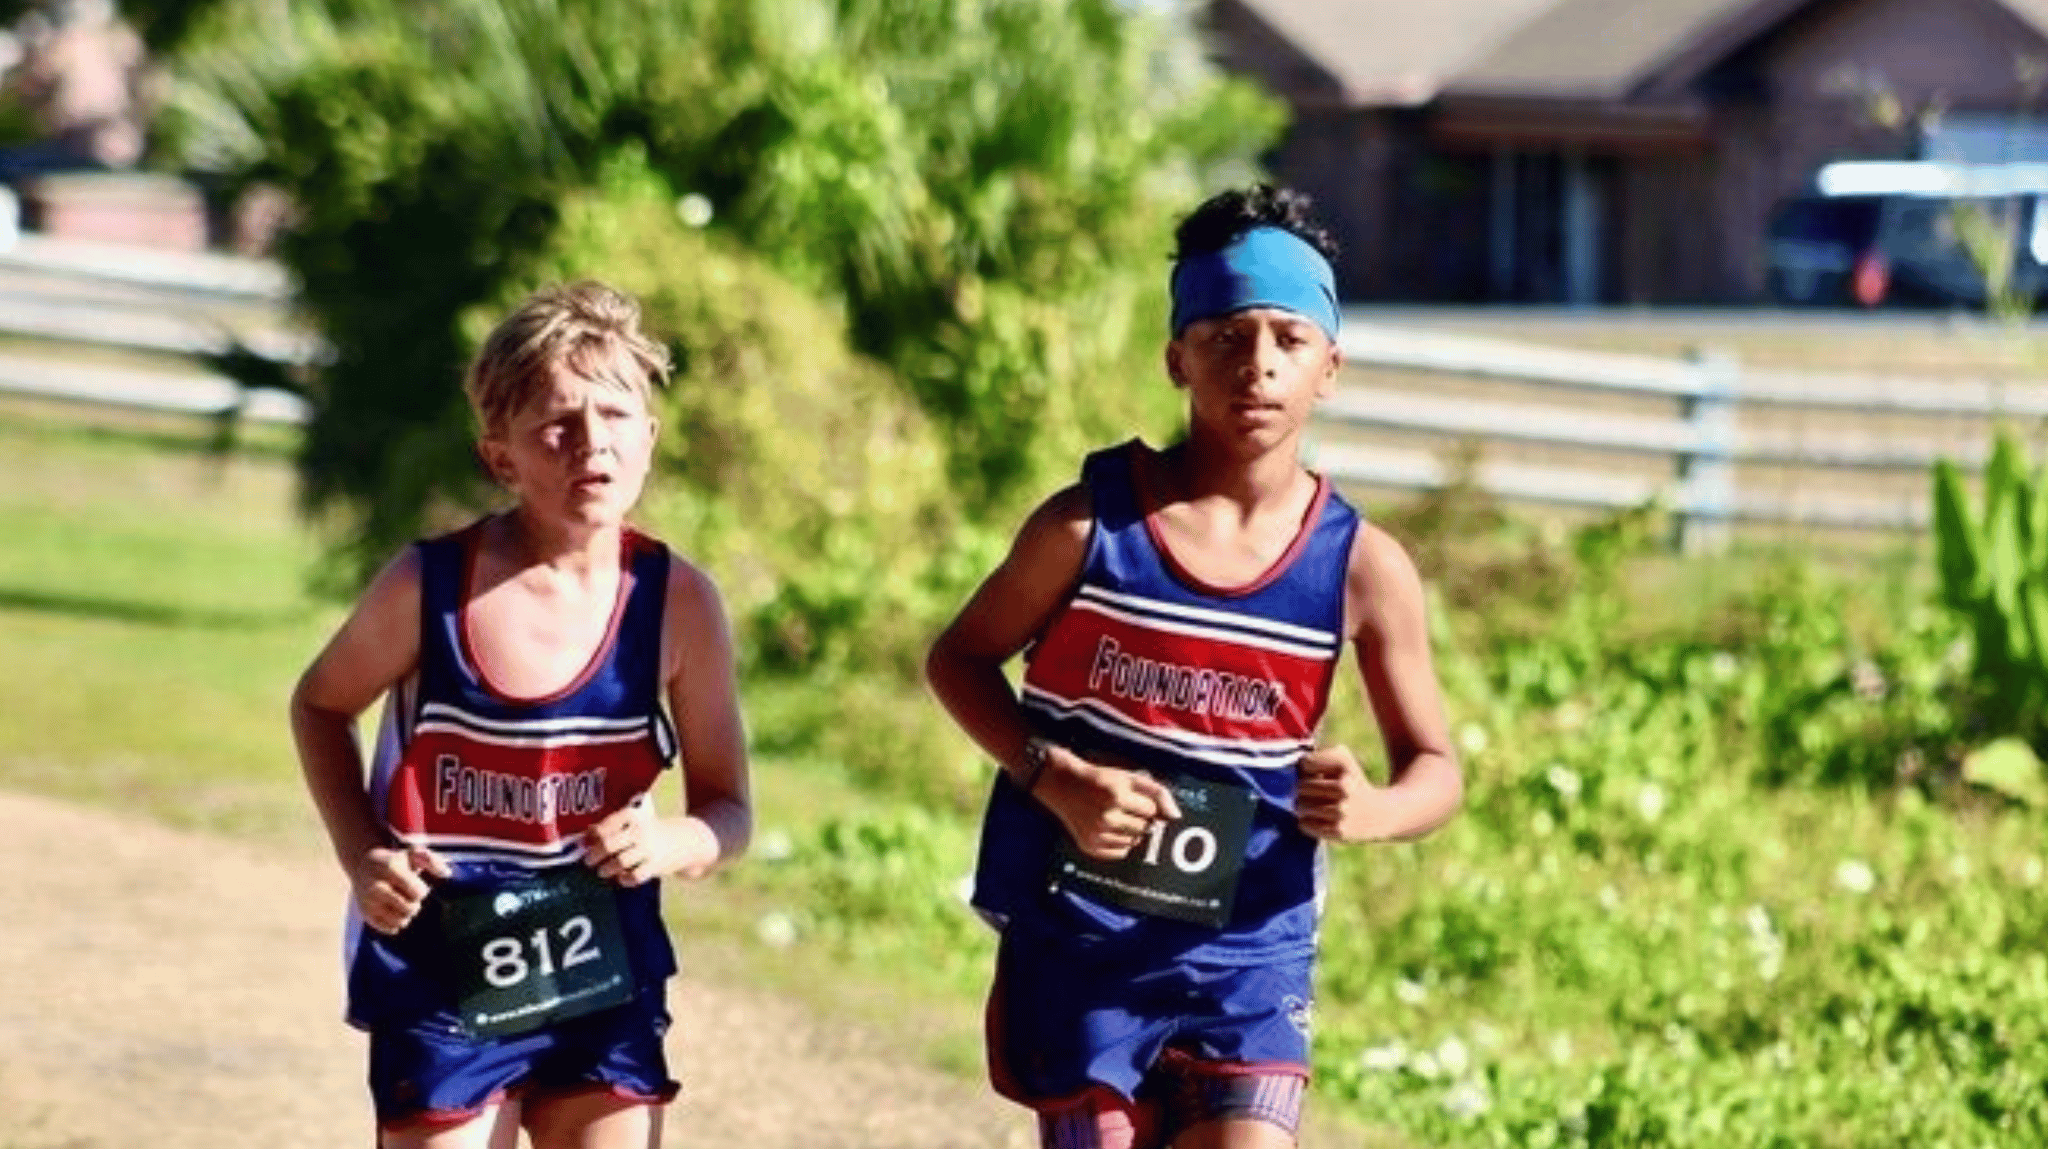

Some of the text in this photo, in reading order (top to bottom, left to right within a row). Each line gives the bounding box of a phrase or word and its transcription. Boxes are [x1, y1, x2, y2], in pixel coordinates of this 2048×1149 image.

[1088, 634, 1285, 721] FOUNDATION
[435, 754, 607, 825] FOUNDATION
[1143, 819, 1217, 874] 10
[482, 915, 600, 988] 812
